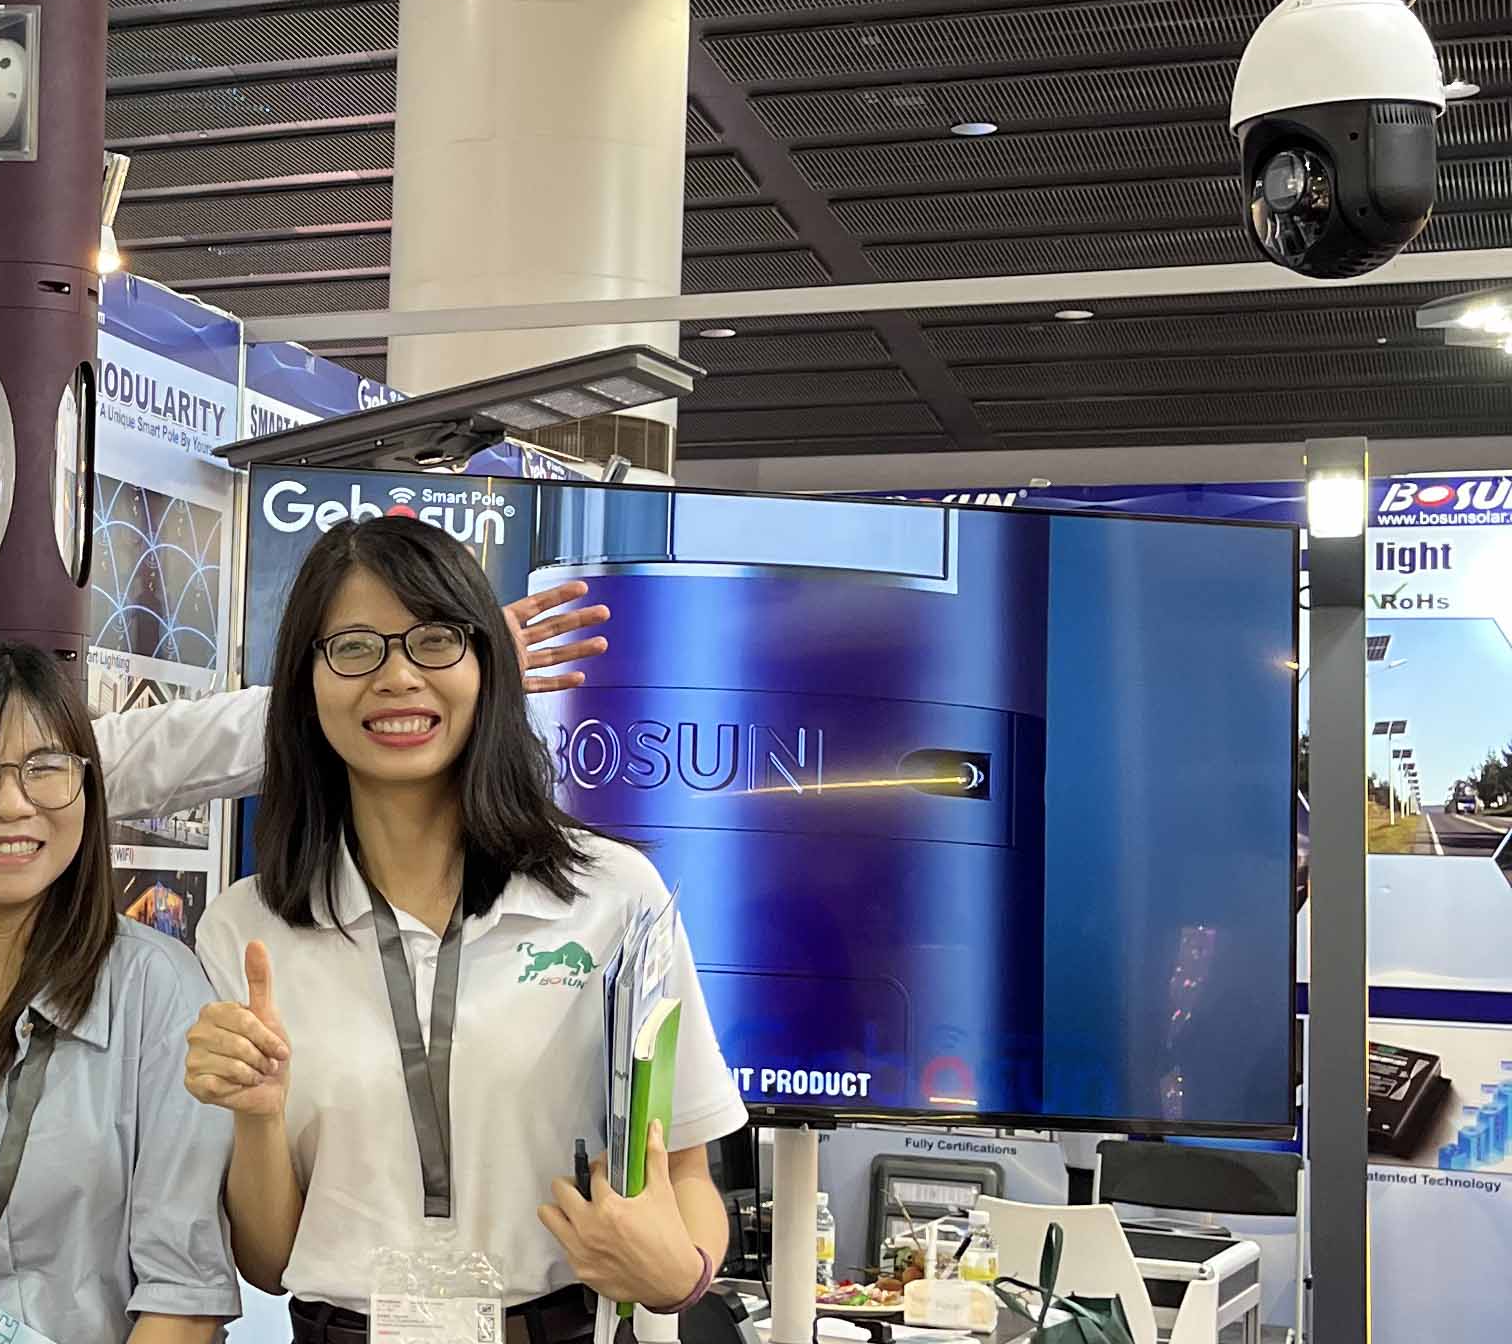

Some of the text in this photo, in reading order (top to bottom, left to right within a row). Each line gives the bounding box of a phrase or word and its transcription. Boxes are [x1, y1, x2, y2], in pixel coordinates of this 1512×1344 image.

[99, 402, 107, 418] A
[108, 404, 136, 430] Unique
[137, 416, 160, 440] Smart
[162, 423, 180, 446] Pole
[180, 430, 191, 449] By
[421, 489, 505, 506] Smart Pole
[1375, 542, 1453, 574] light
[760, 1068, 872, 1097] PRODUCT
[904, 1137, 933, 1152] Fully
[937, 1140, 1018, 1156] Certifications
[1422, 1174, 1502, 1193] Technology
